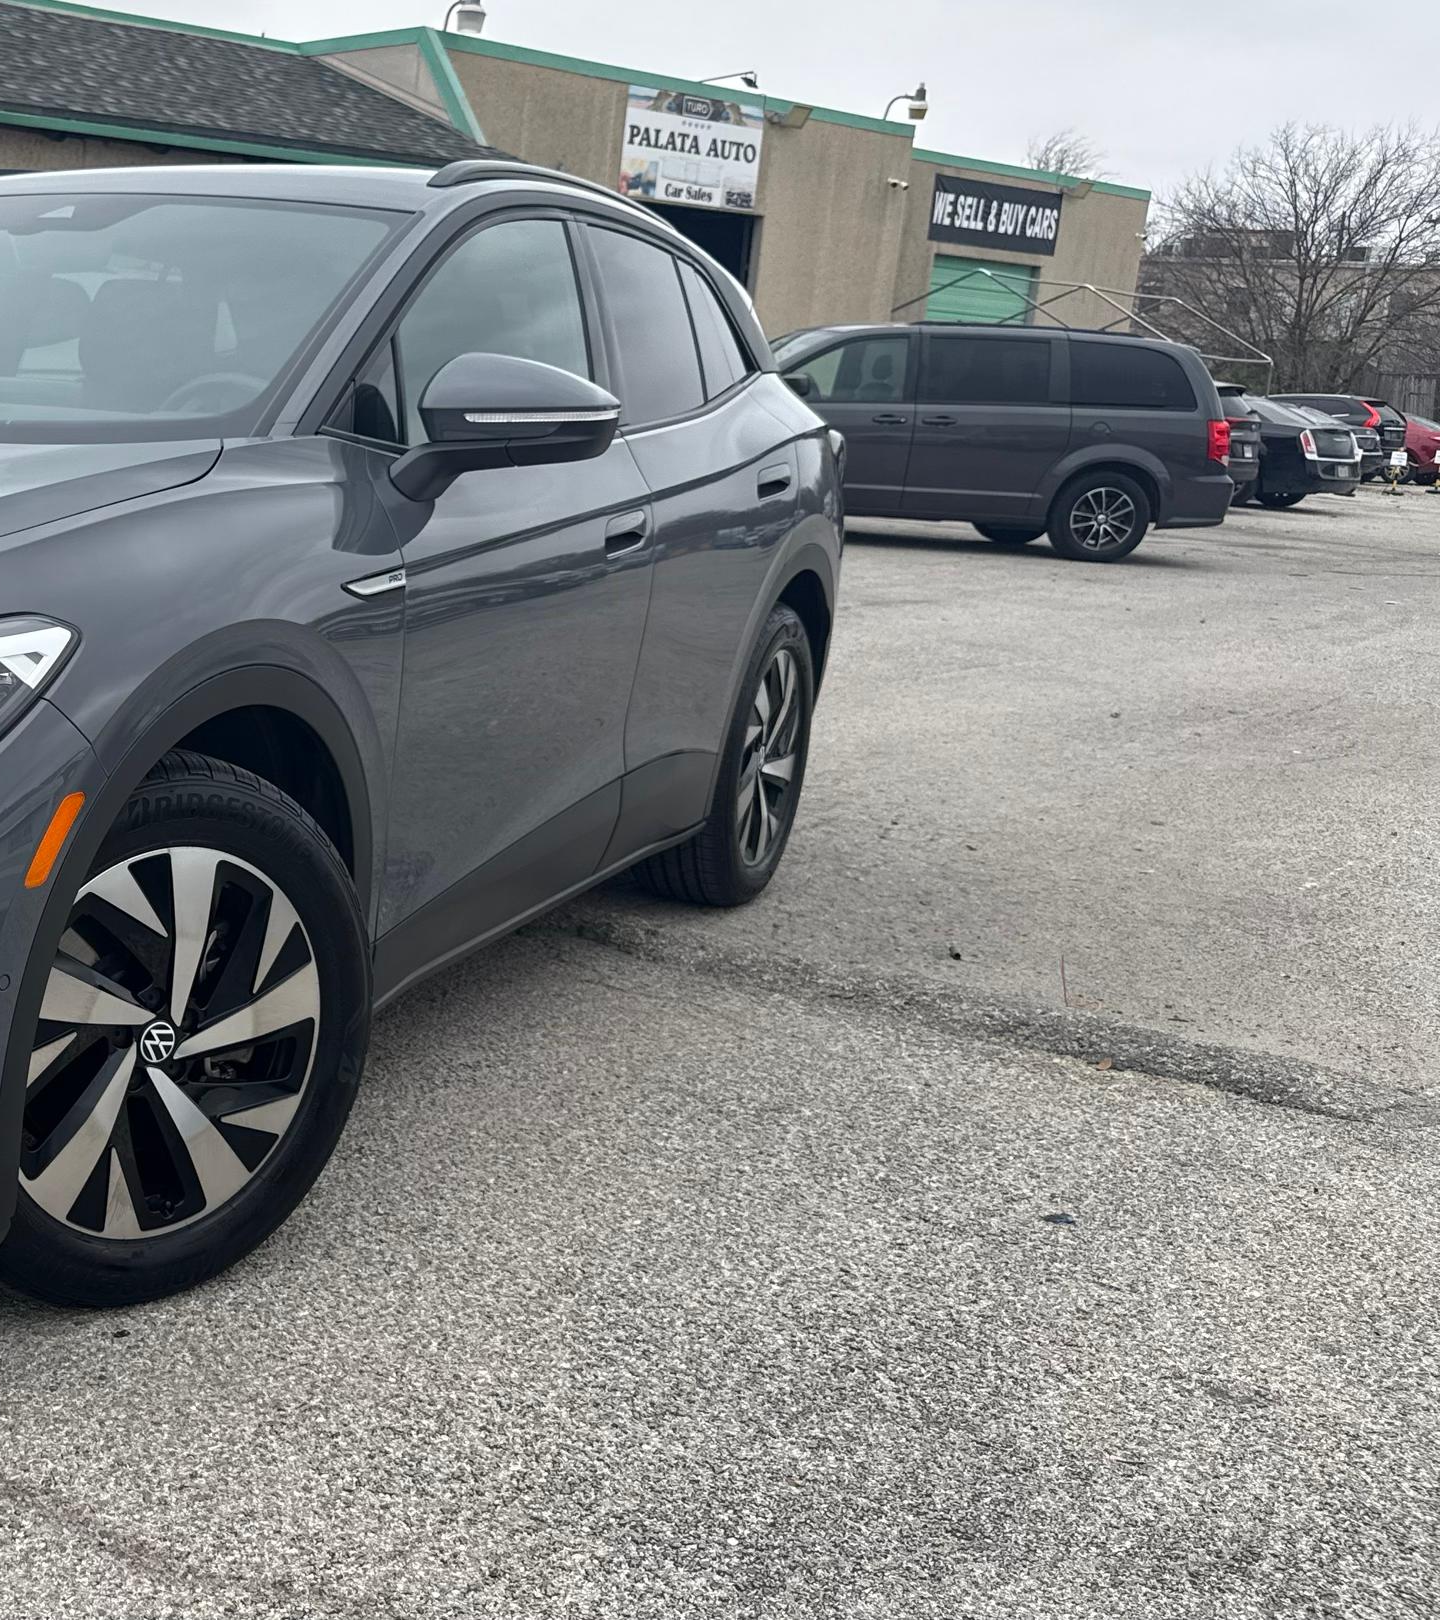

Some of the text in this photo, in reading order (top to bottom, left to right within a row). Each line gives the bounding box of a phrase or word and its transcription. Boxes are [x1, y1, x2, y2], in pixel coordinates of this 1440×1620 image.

[686, 101, 709, 114] TURO
[627, 124, 757, 164] PALATA AUTO
[664, 183, 684, 199] Car
[685, 186, 713, 203] Sales
[932, 191, 1058, 240] WE SELL & BUY CARS
[388, 573, 403, 584] PRO
